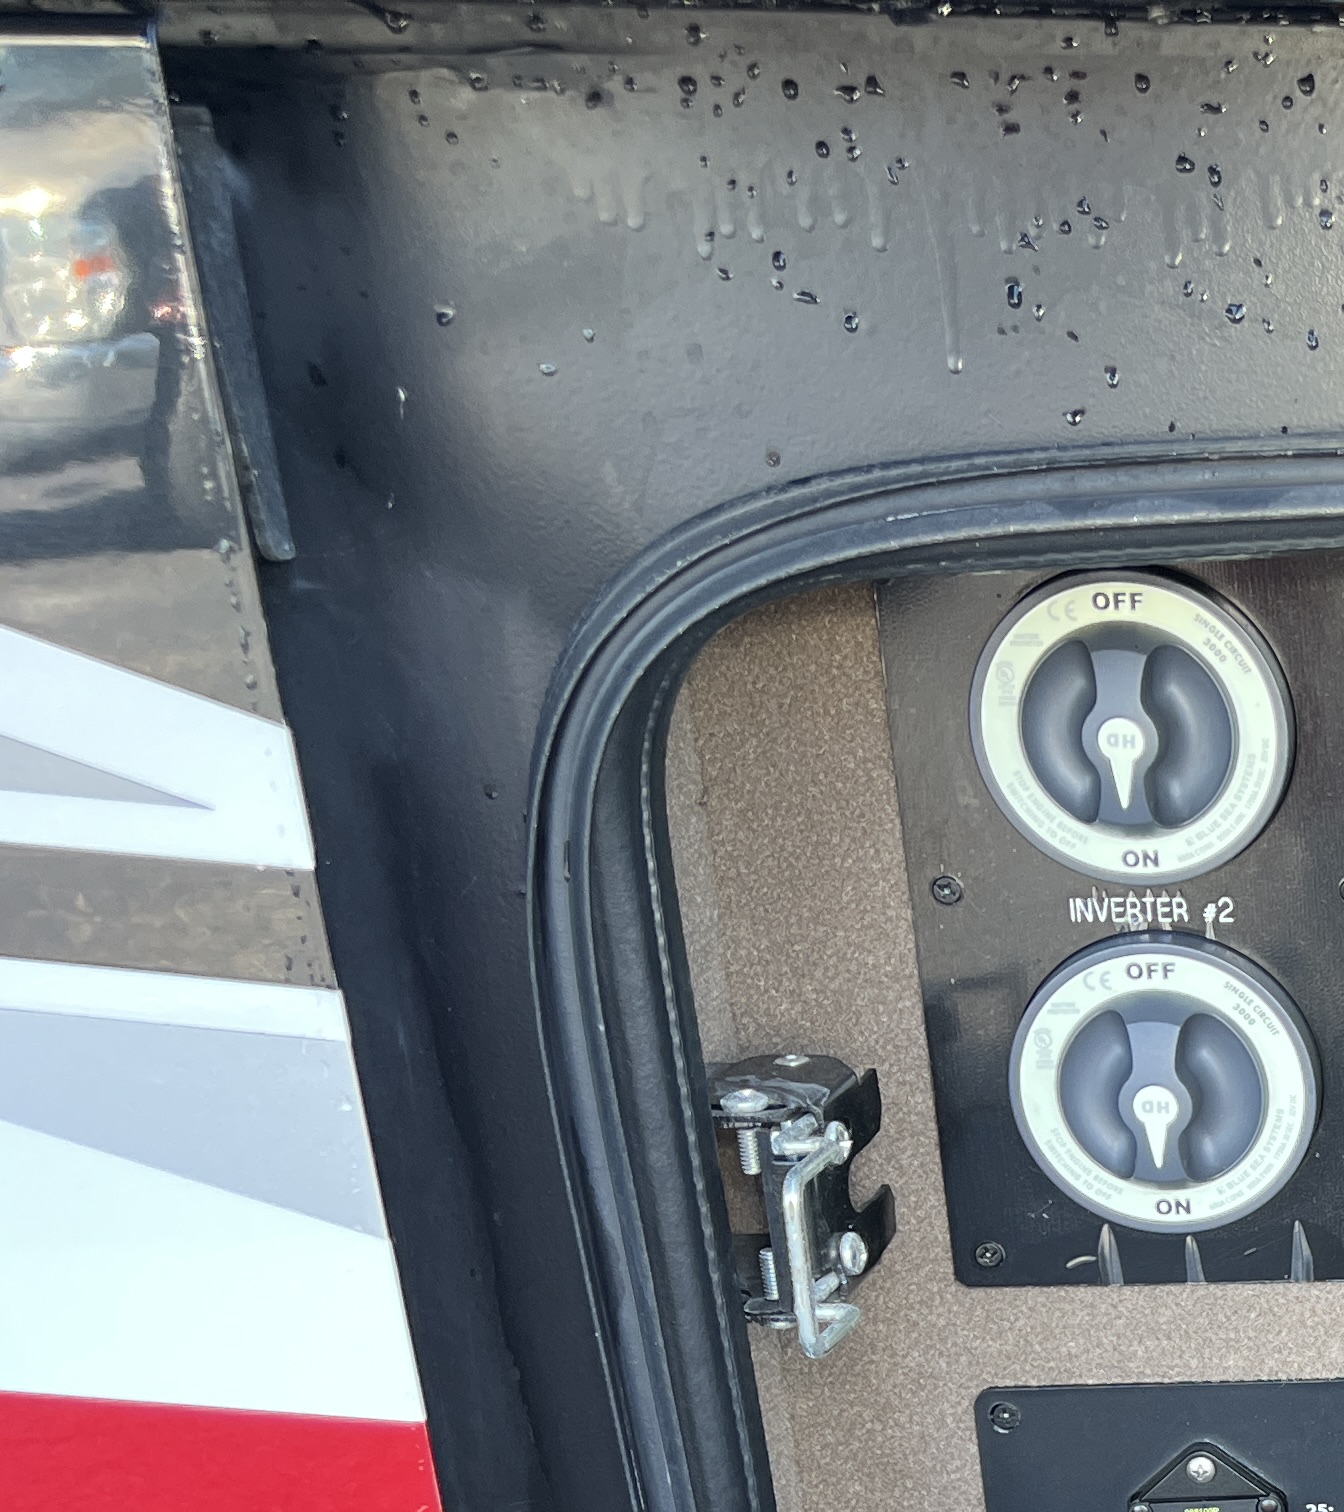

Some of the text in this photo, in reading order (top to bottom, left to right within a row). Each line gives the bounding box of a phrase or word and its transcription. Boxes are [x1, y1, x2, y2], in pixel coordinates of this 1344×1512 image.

[1092, 593, 1143, 611] OFF
[1194, 613, 1252, 674] SINGLE CIRCUIT
[1203, 638, 1227, 663] 3000
[1106, 733, 1136, 749] HD
[1122, 850, 1160, 868] ON
[1069, 897, 1236, 924] INVERTER #2
[1125, 962, 1176, 980] OFF
[1223, 981, 1280, 1036] SINGLE CIRCUIT
[1233, 1003, 1256, 1025] 3000
[1141, 1100, 1170, 1114] HD
[1226, 1169, 1251, 1191] BLUE
[1250, 1154, 1267, 1172] SEA
[1263, 1109, 1285, 1154] SYSTEMS
[1156, 1199, 1192, 1215] ON
